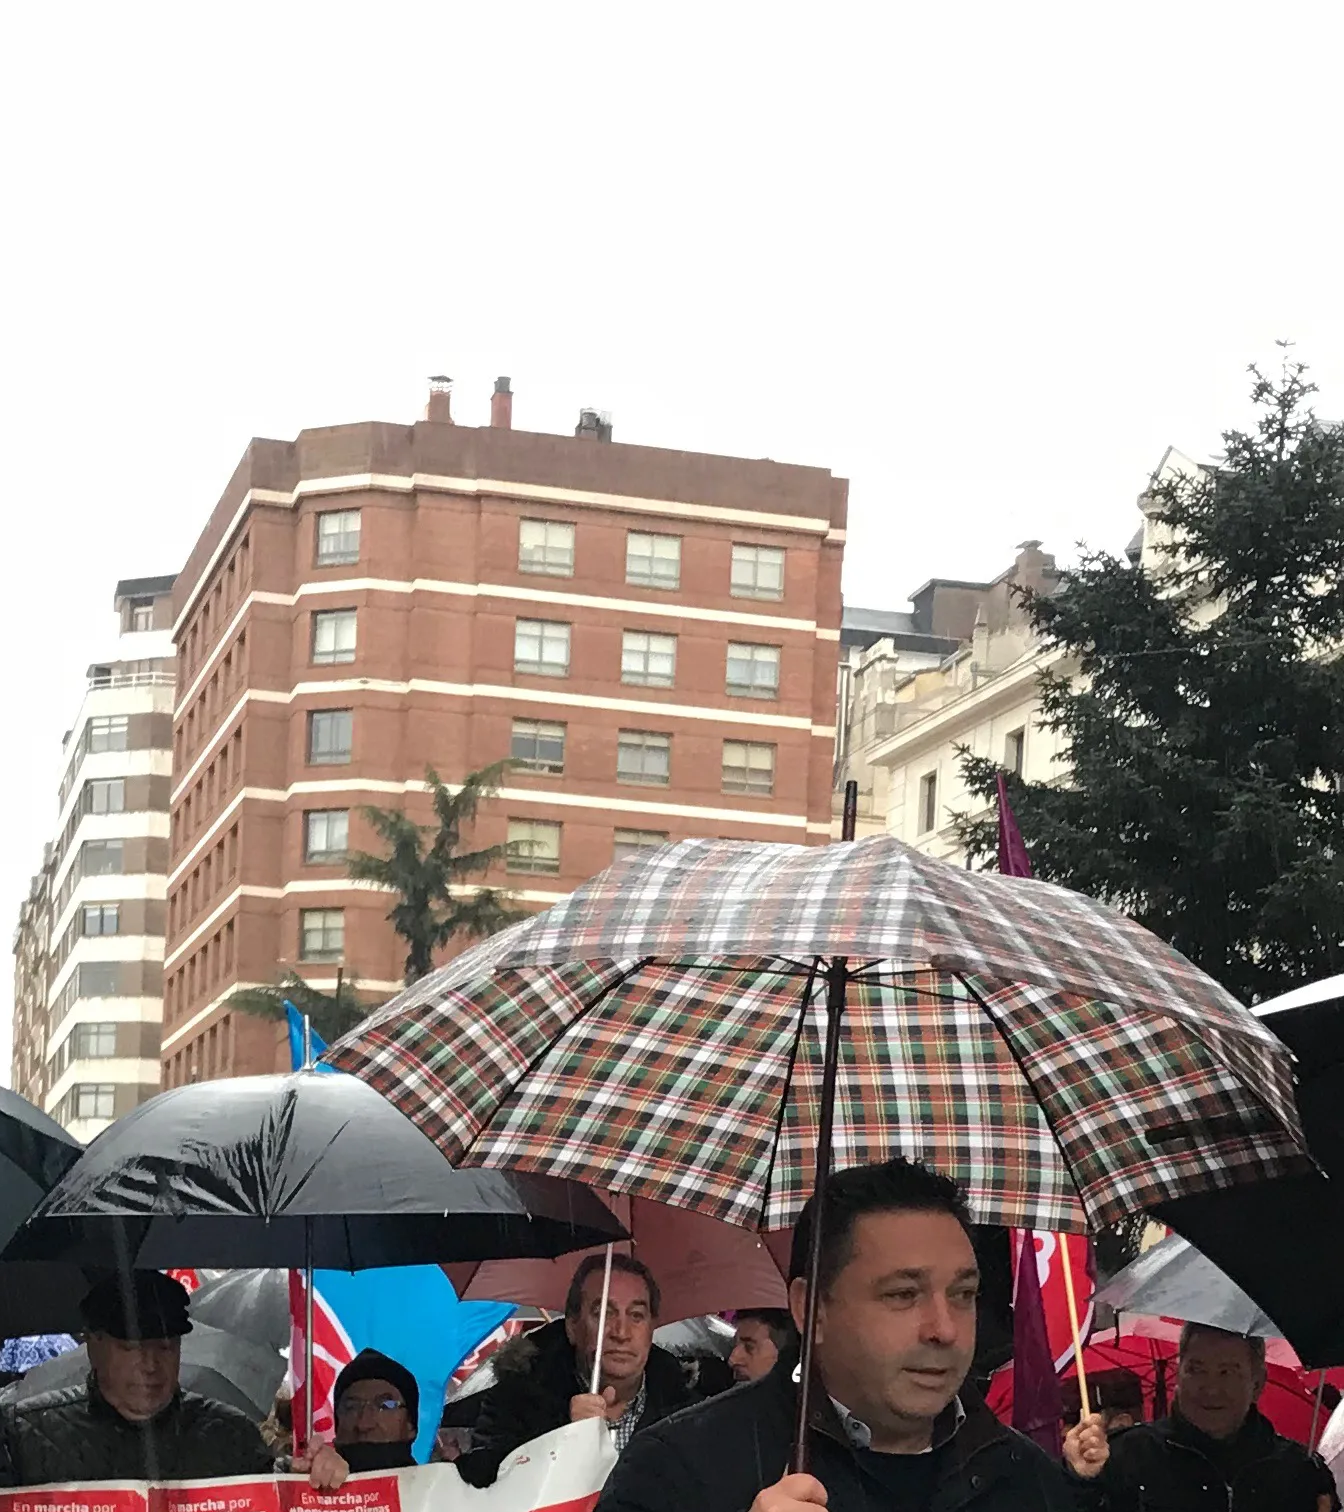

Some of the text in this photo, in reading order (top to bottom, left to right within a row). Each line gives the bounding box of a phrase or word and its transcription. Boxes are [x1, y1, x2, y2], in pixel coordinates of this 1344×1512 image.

[229, 1498, 252, 1512] por
[364, 1491, 379, 1505] por
[13, 1501, 30, 1512] En
